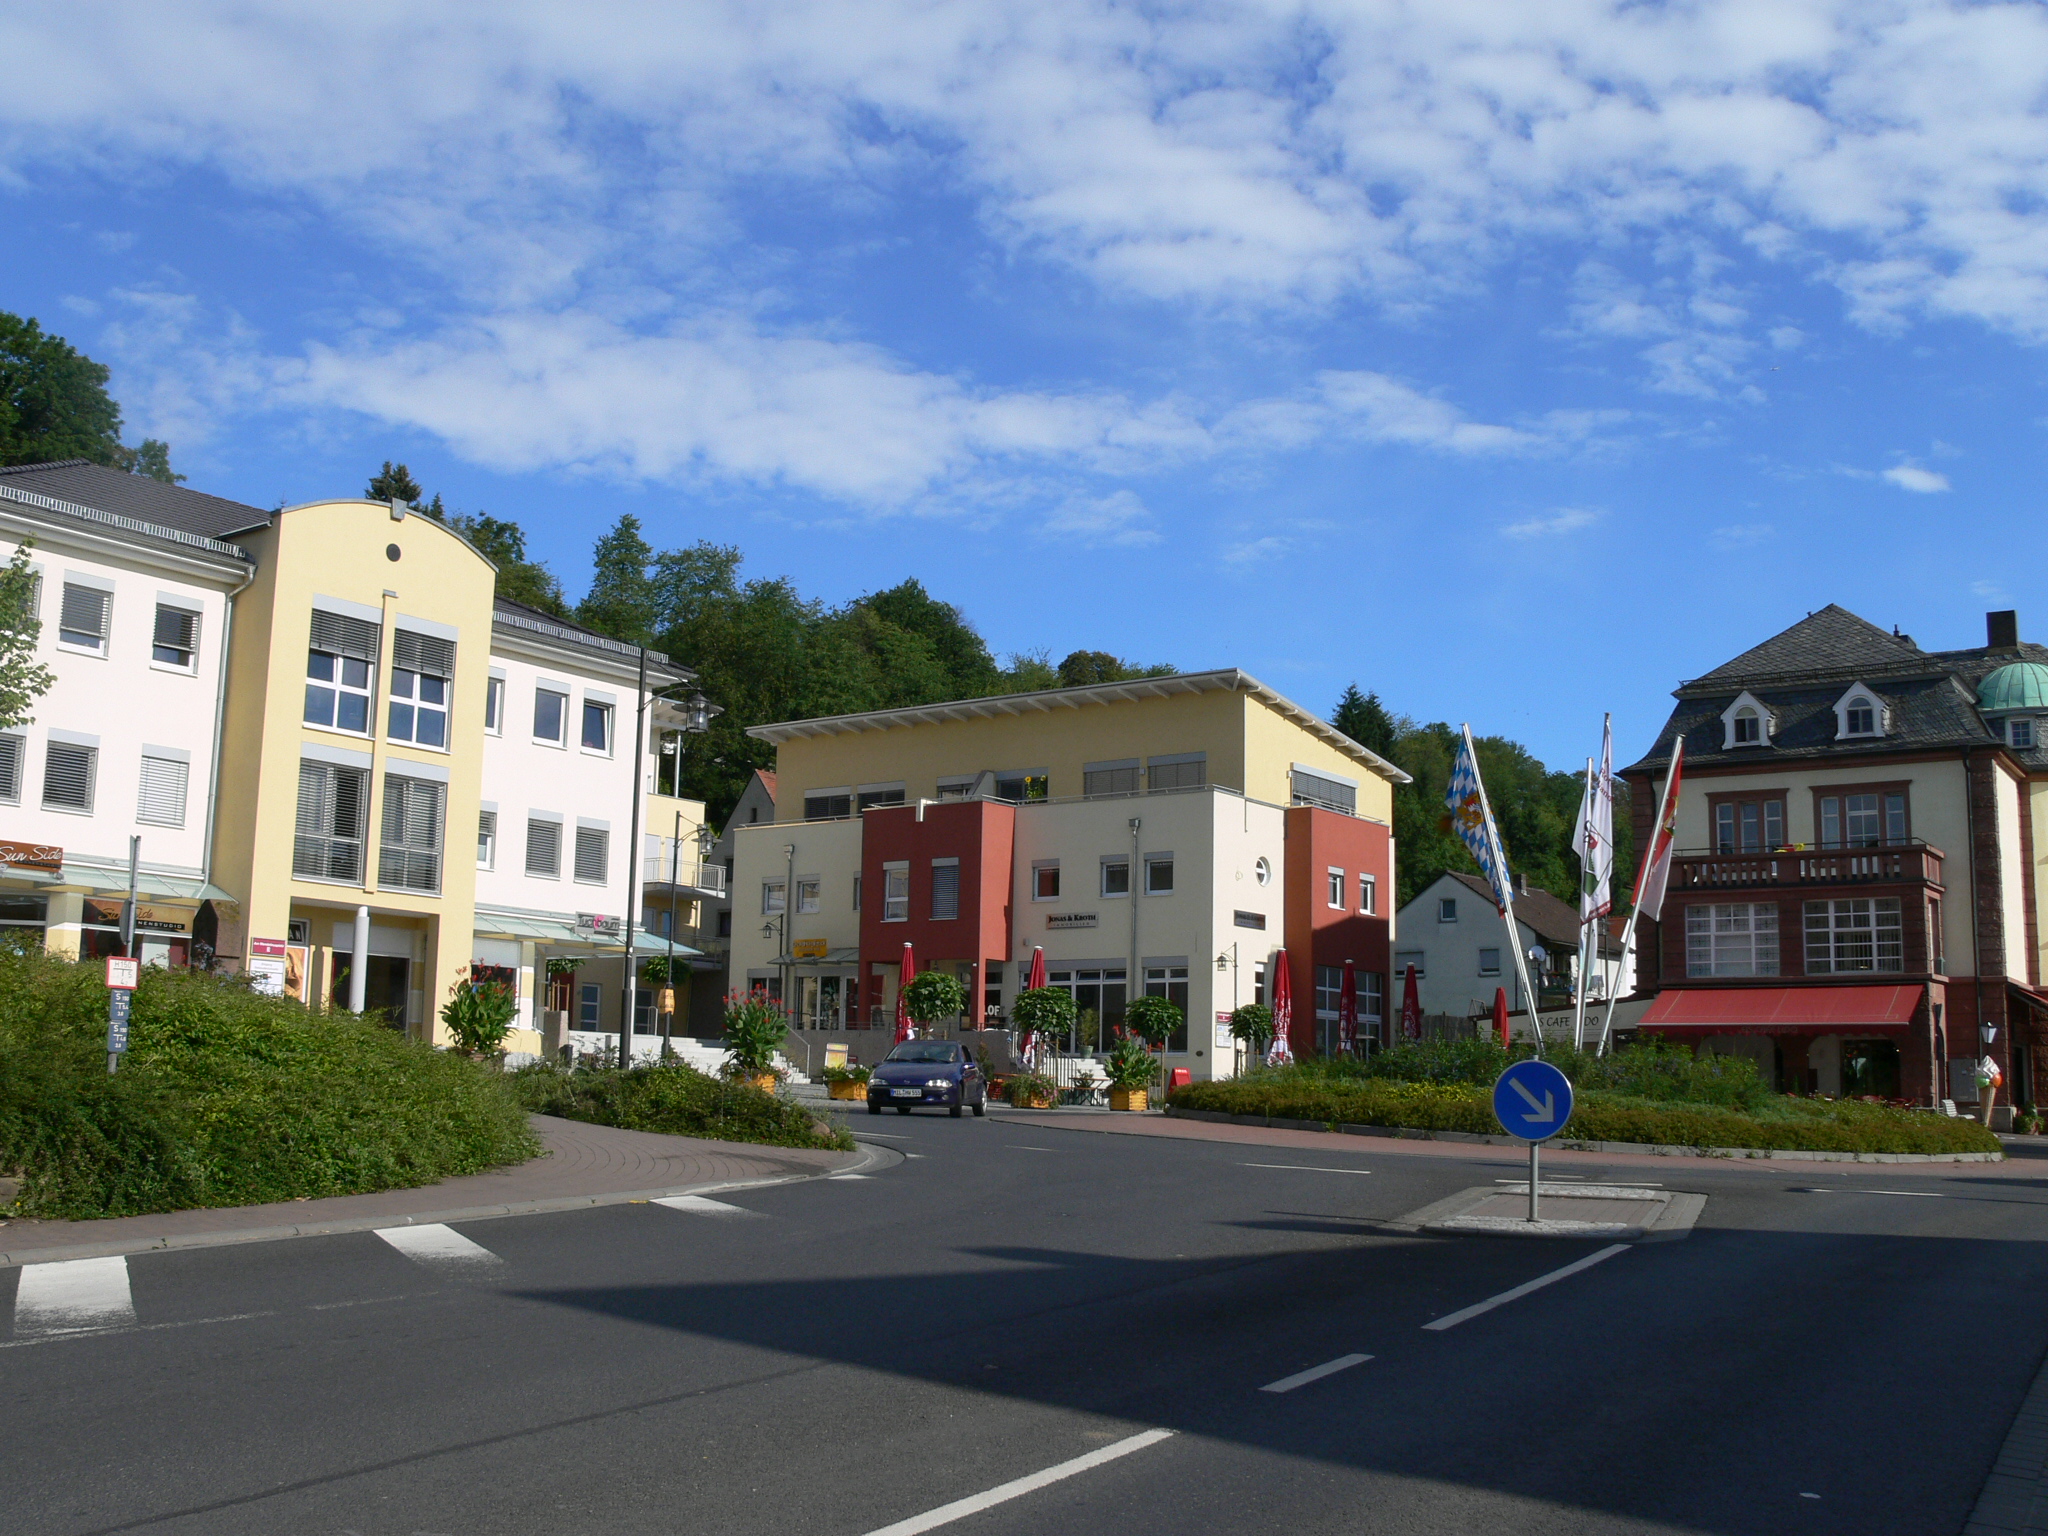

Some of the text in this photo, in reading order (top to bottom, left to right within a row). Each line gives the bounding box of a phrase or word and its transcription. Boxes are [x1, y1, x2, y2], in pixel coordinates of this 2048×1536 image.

[0, 846, 62, 861] Sun Side
[98, 908, 120, 920] Su
[1048, 915, 1066, 923] JONAS
[1074, 914, 1096, 922] KROTH
[1546, 1016, 1571, 1027] CAFE
